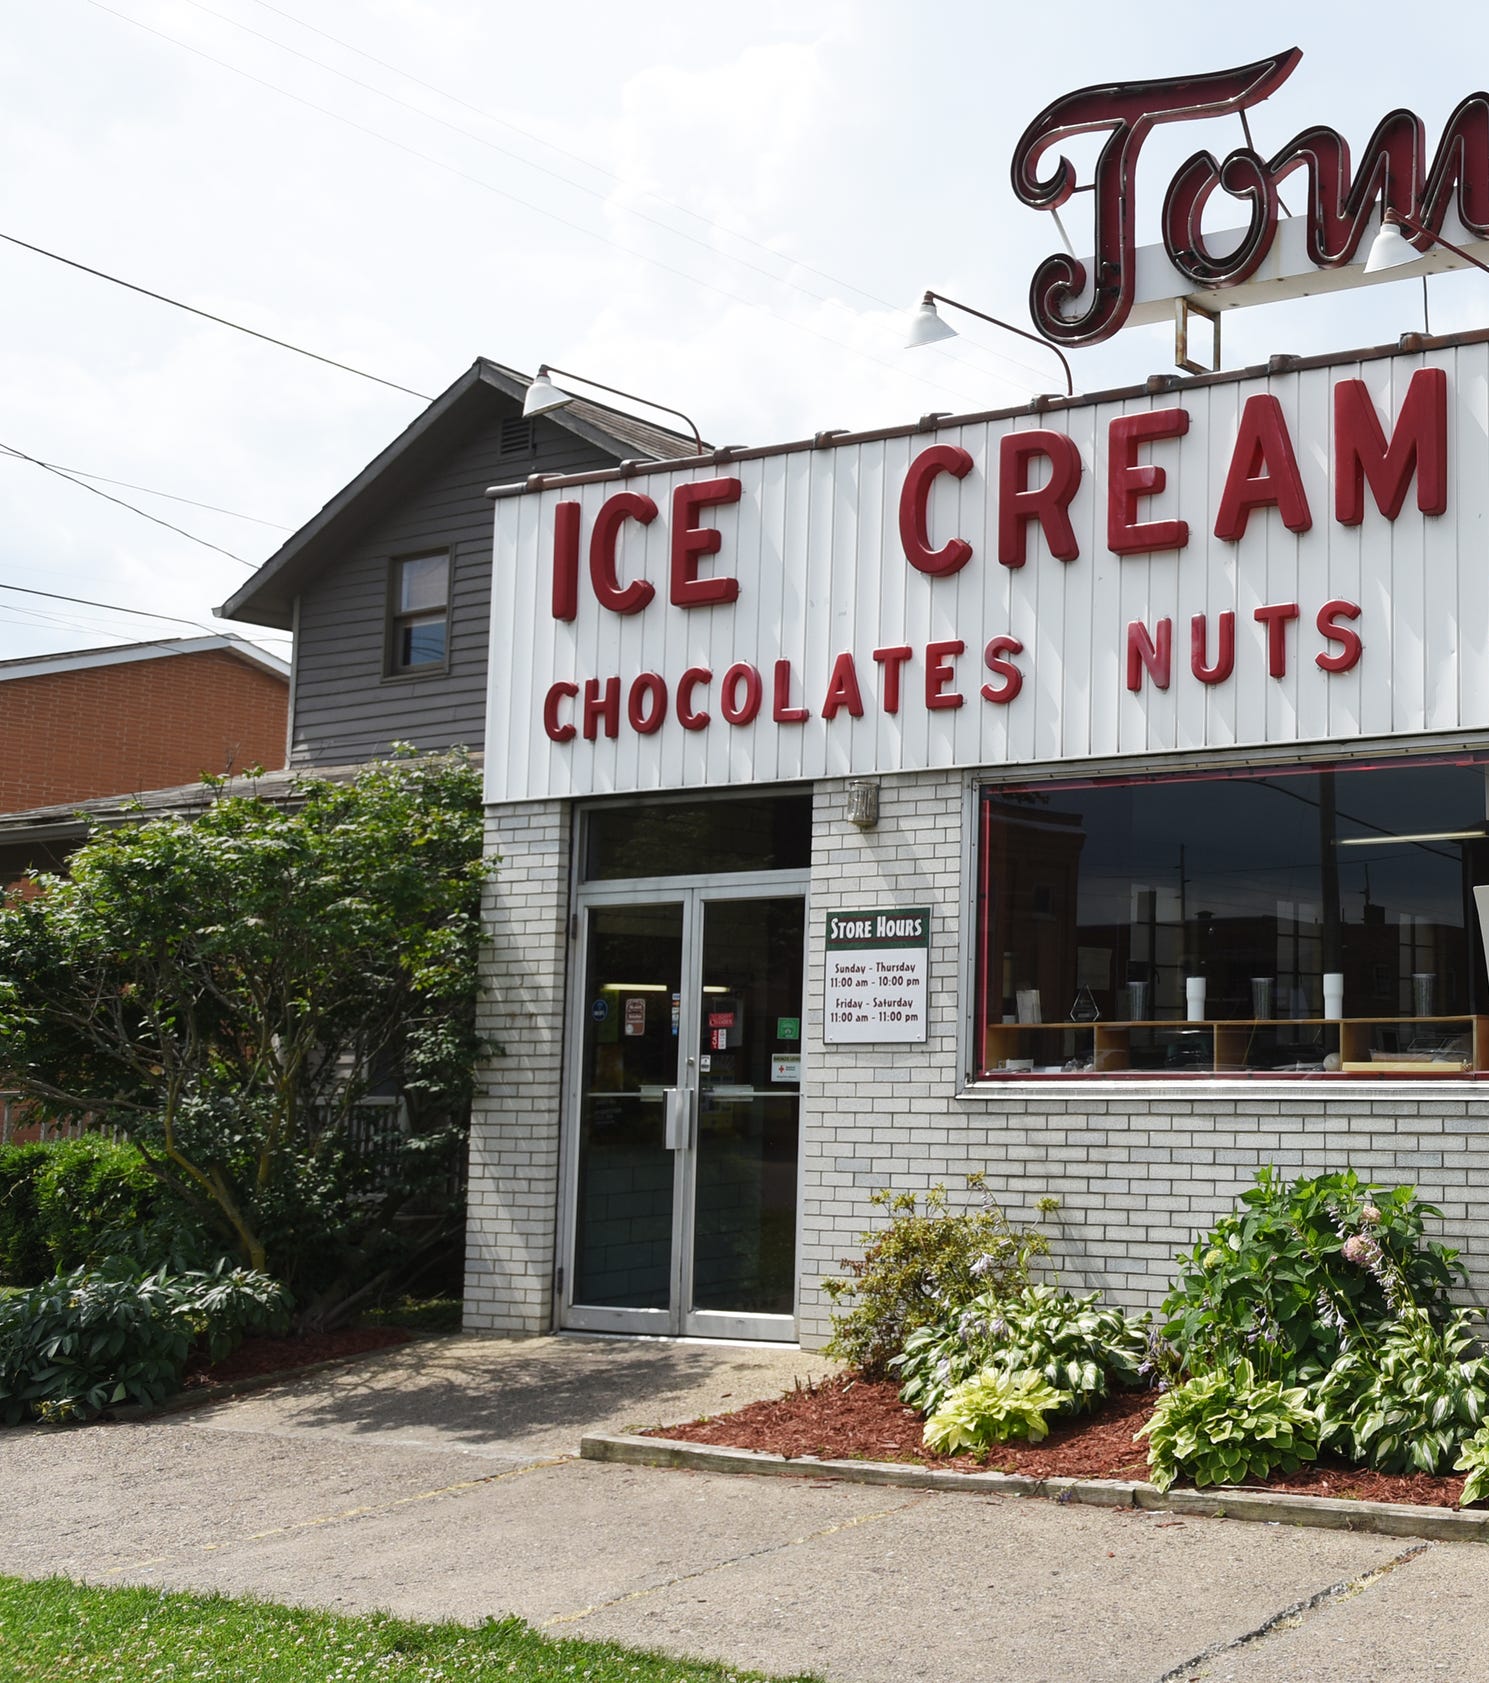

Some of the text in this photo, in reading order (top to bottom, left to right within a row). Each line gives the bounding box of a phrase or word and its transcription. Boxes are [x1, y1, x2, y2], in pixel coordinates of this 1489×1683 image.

[550, 475, 743, 623] ICE
[898, 367, 1448, 578] CREAM
[542, 633, 1025, 743] CHOCOLATES
[1125, 597, 1364, 692] NUTS
[835, 963, 866, 974] Sunday
[876, 962, 916, 973] Thursday
[830, 977, 853, 988] 11:00
[855, 979, 868, 987] am
[878, 976, 903, 987] 10:00
[906, 978, 920, 987] pm
[836, 998, 863, 1009] Friday
[873, 997, 913, 1009] Saturday
[830, 1012, 853, 1023] 11:00
[878, 1011, 902, 1022] 11:00
[905, 1013, 918, 1023] pm
